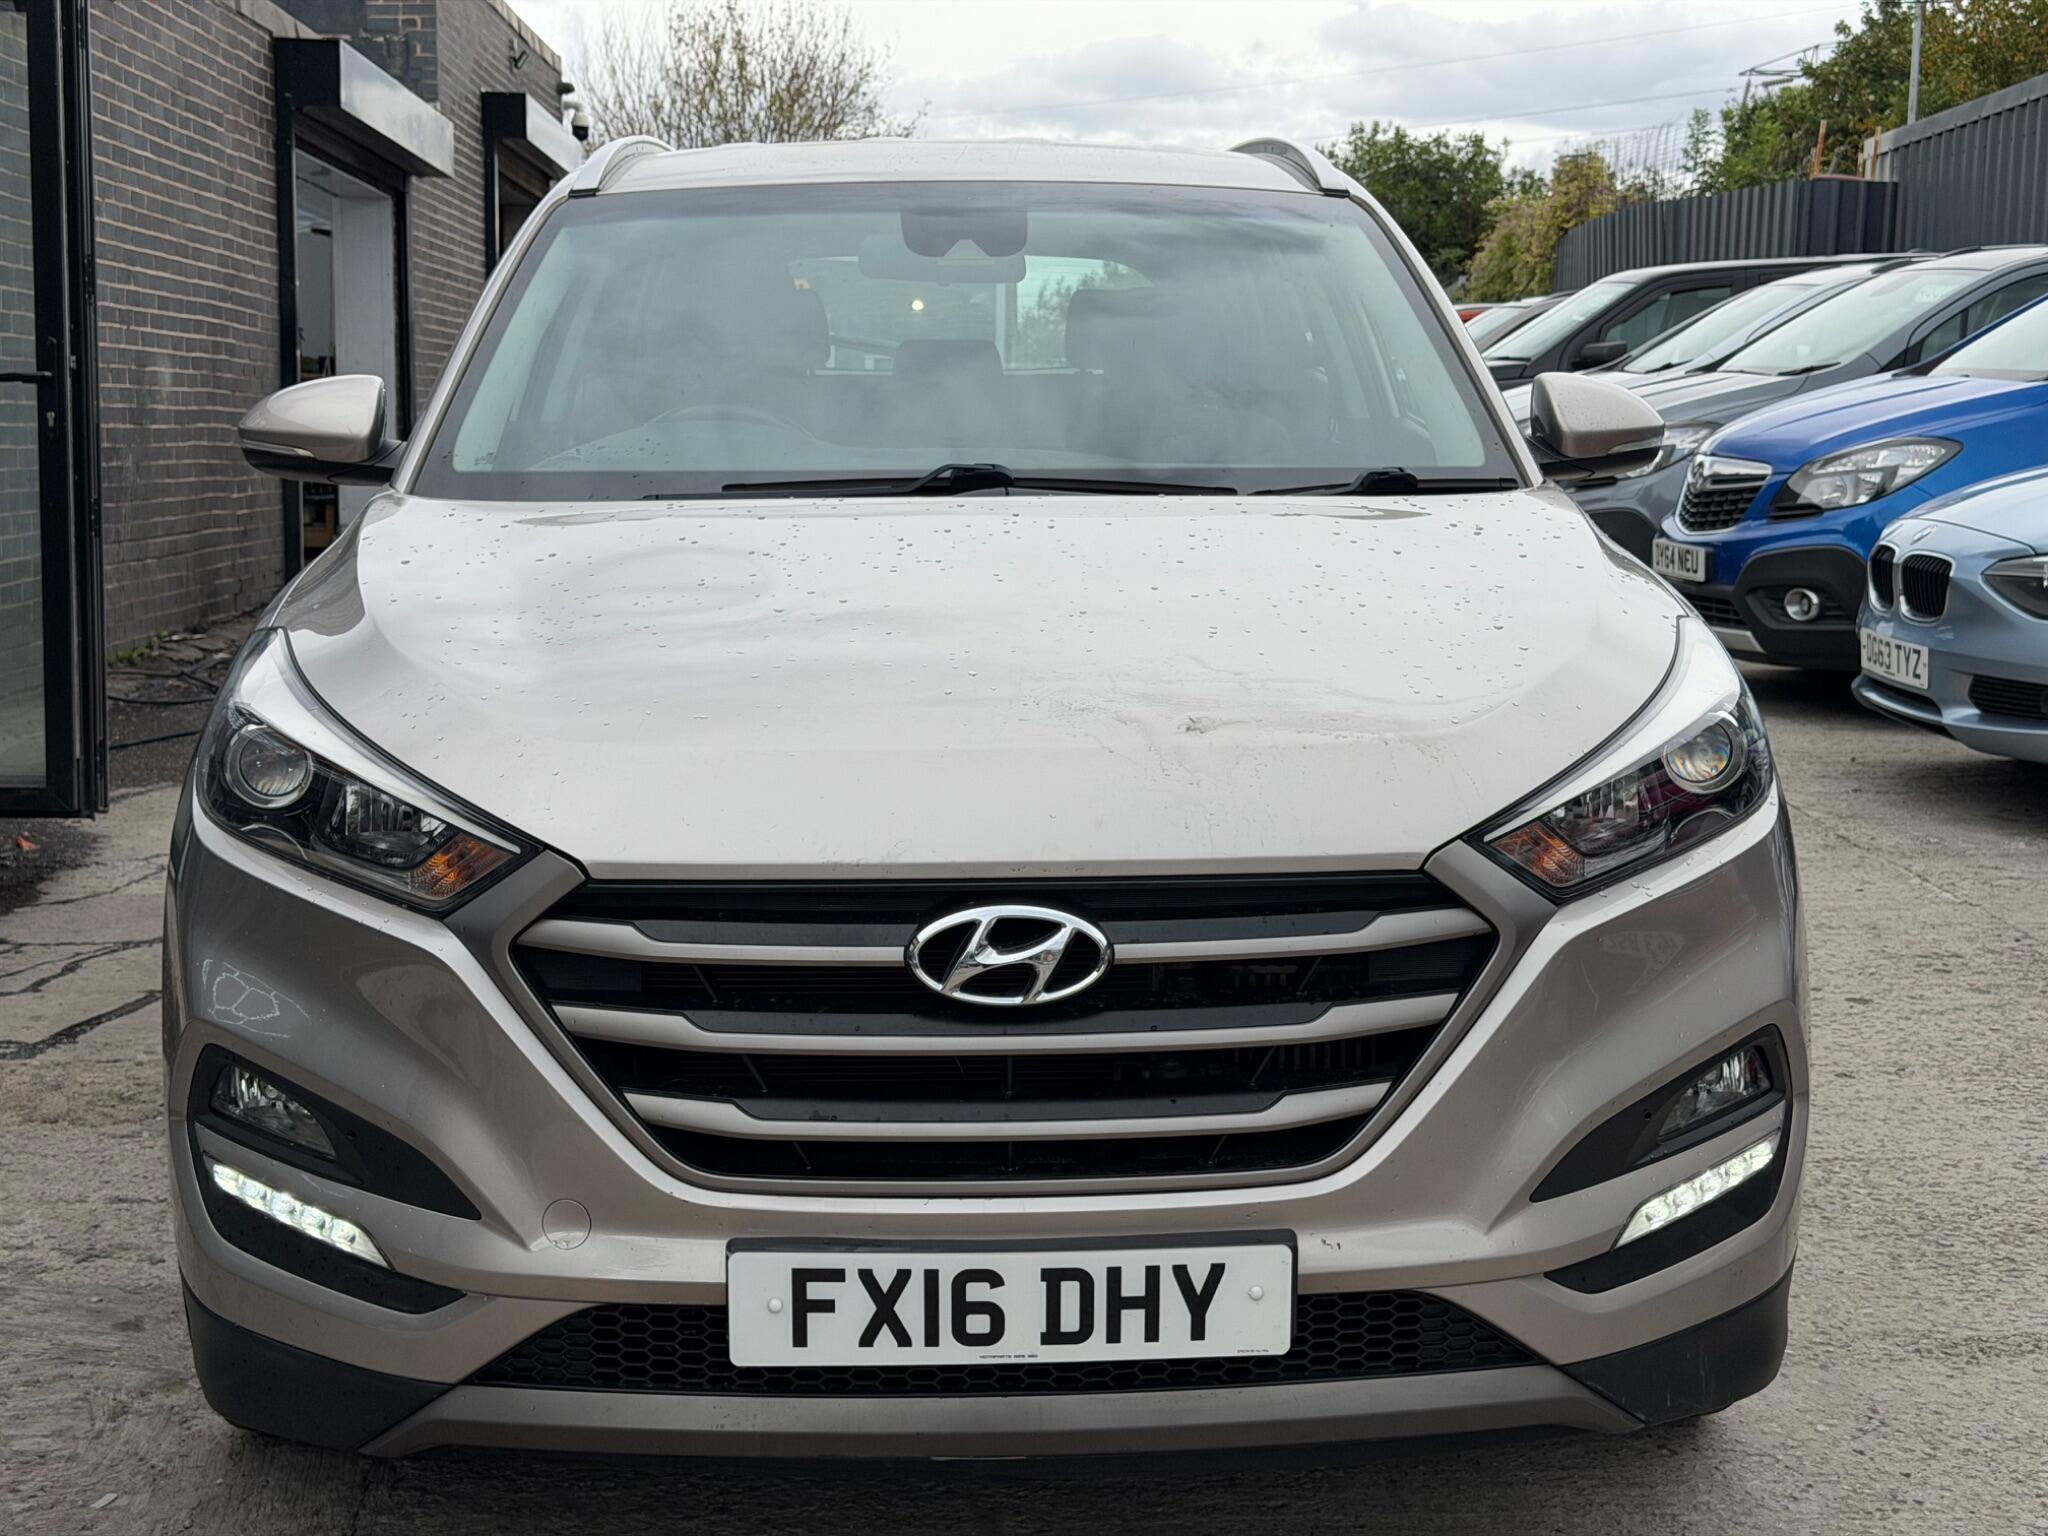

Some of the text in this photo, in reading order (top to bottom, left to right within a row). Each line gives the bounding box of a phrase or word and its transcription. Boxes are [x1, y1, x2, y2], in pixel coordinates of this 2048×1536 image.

[1678, 546, 1698, 574] NEU
[1867, 632, 1922, 680] DG63 TYZ
[792, 1262, 1227, 1348] FX16 DHY
